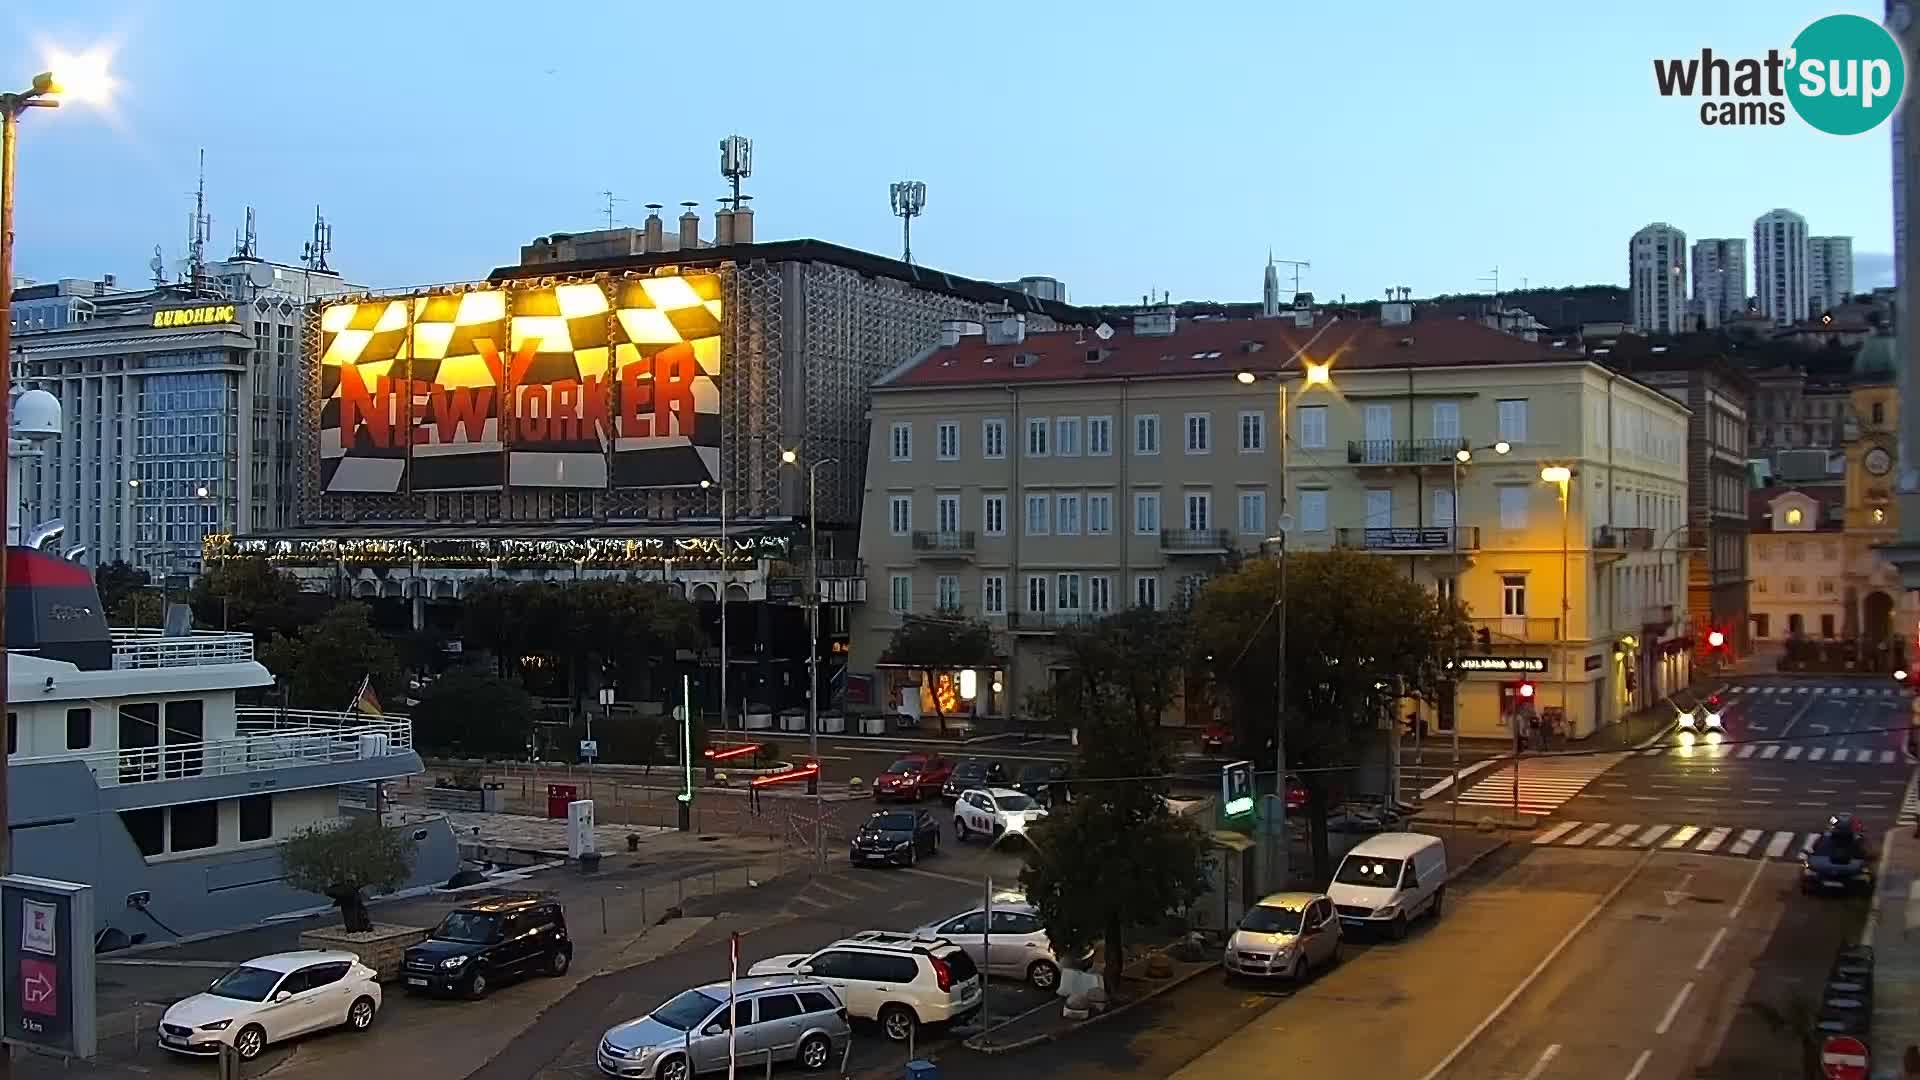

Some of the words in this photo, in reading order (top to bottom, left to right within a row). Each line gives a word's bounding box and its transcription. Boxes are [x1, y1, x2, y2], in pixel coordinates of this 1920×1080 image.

[341, 359, 492, 449] NEW
[473, 337, 697, 442] YORKER
[29, 1019, 43, 1033] km
